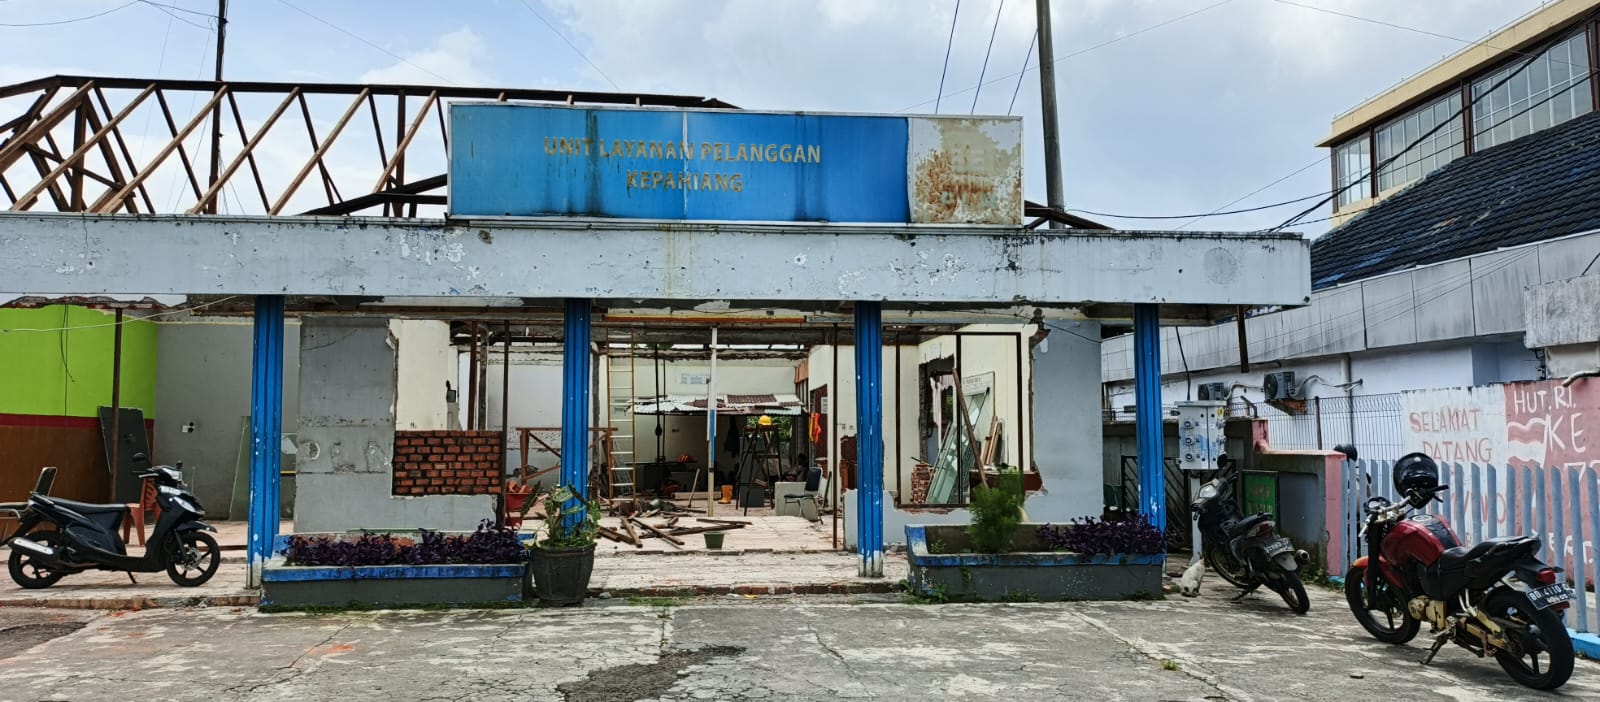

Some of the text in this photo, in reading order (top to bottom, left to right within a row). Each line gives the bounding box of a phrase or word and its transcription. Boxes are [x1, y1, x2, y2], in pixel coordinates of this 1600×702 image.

[544, 137, 820, 163] UNIT LAYANAN PELANGGAN
[626, 170, 743, 192] KEPAHIANG
[1409, 406, 1480, 433] SELAMAT
[1547, 412, 1586, 453] KE
[1423, 437, 1492, 463] DATANG
